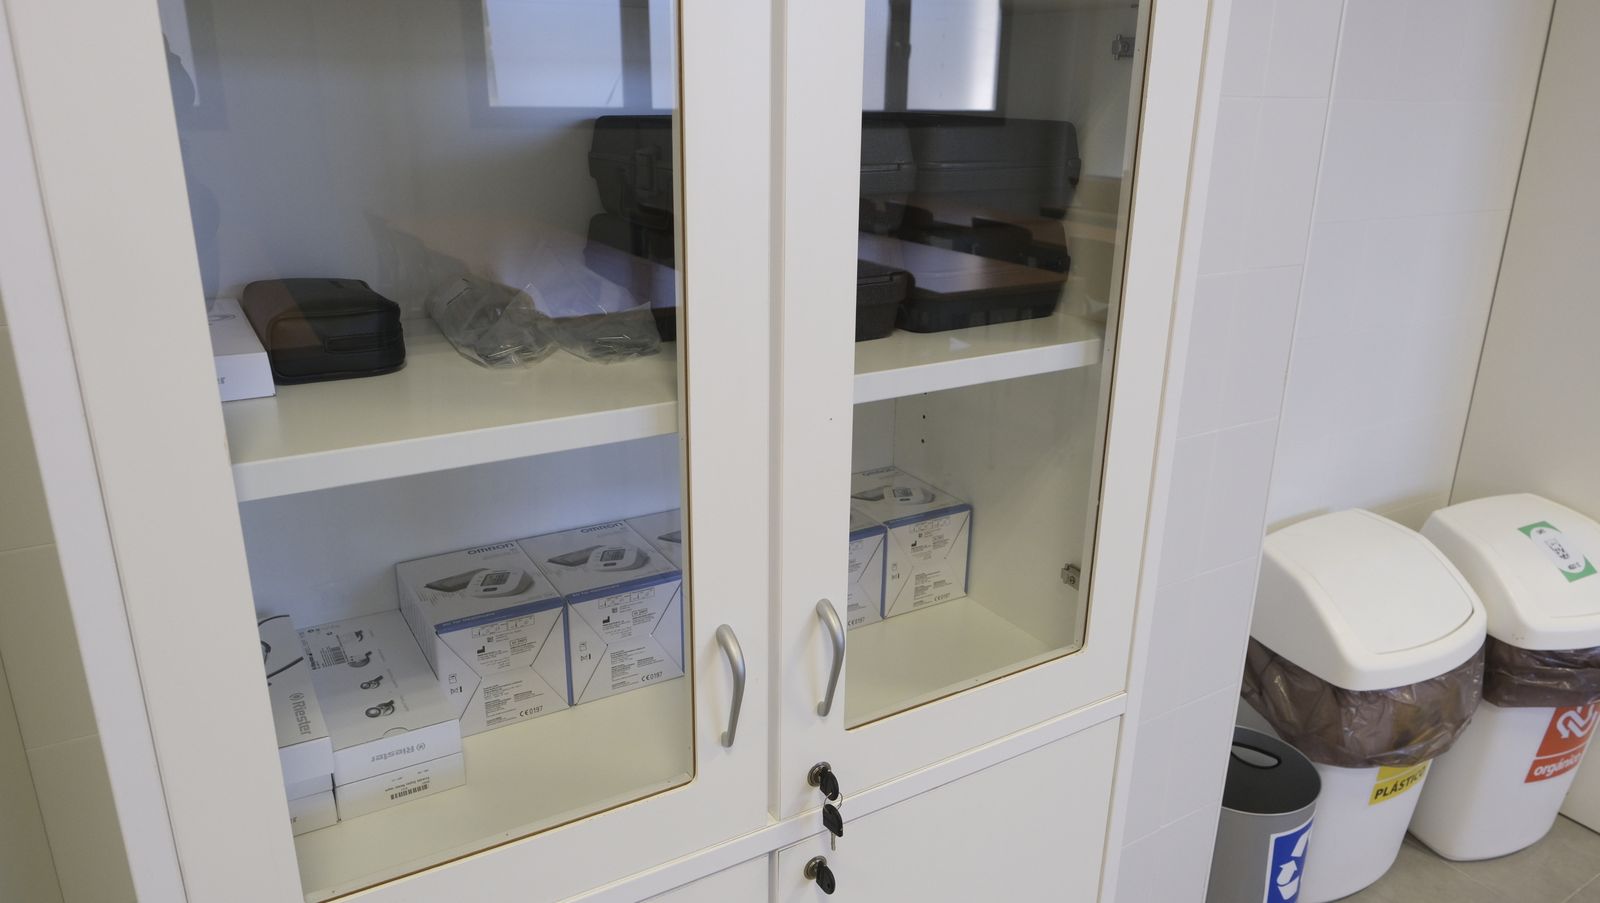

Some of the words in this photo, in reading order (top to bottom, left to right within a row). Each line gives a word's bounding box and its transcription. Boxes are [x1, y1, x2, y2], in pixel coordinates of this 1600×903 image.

[467, 543, 514, 554] omron
[291, 700, 311, 735] Riester
[371, 745, 415, 762] Riester
